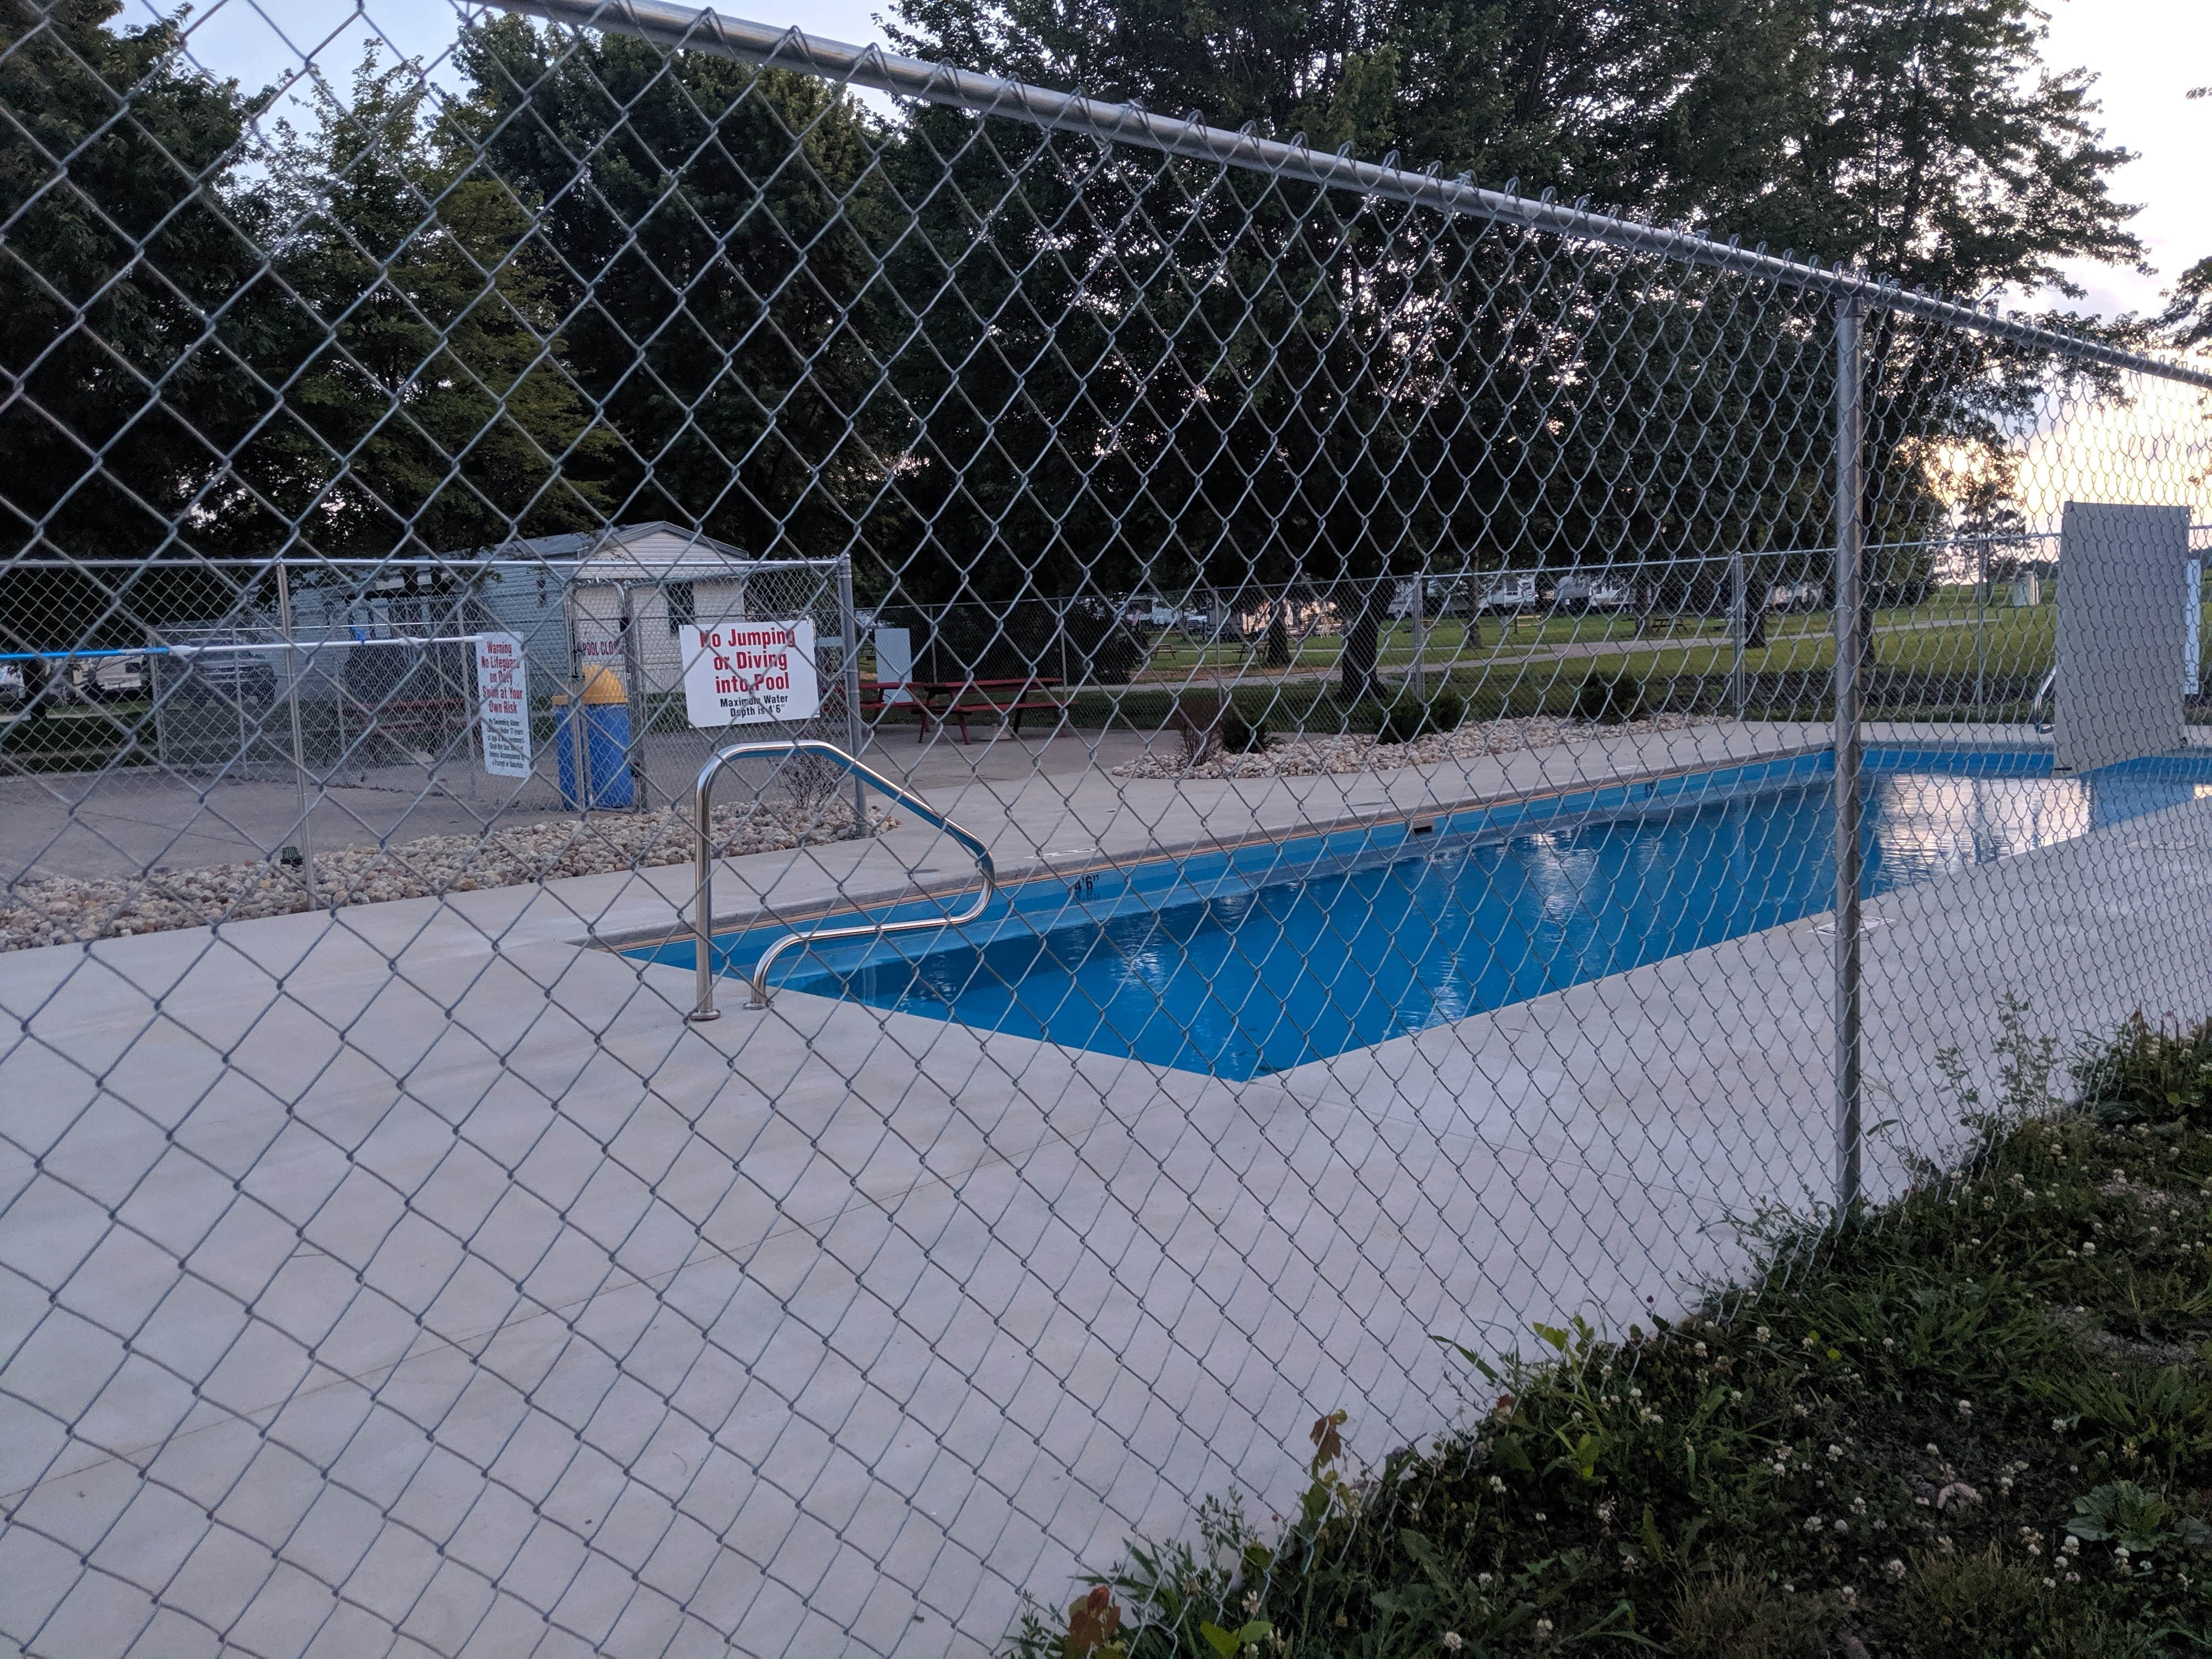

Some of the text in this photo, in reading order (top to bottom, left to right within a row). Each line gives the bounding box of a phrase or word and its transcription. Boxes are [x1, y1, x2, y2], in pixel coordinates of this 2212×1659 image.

[728, 627, 796, 649] Jumping
[487, 641, 512, 657] Warning
[481, 656, 489, 668] No
[713, 650, 788, 671] or Diving
[489, 673, 497, 682] on
[715, 672, 789, 694] into Pool
[500, 686, 507, 698] at
[509, 686, 522, 699] Your
[763, 695, 788, 704] Water
[489, 700, 518, 714] Own Risk
[730, 706, 755, 718] Depth
[758, 706, 765, 715] is
